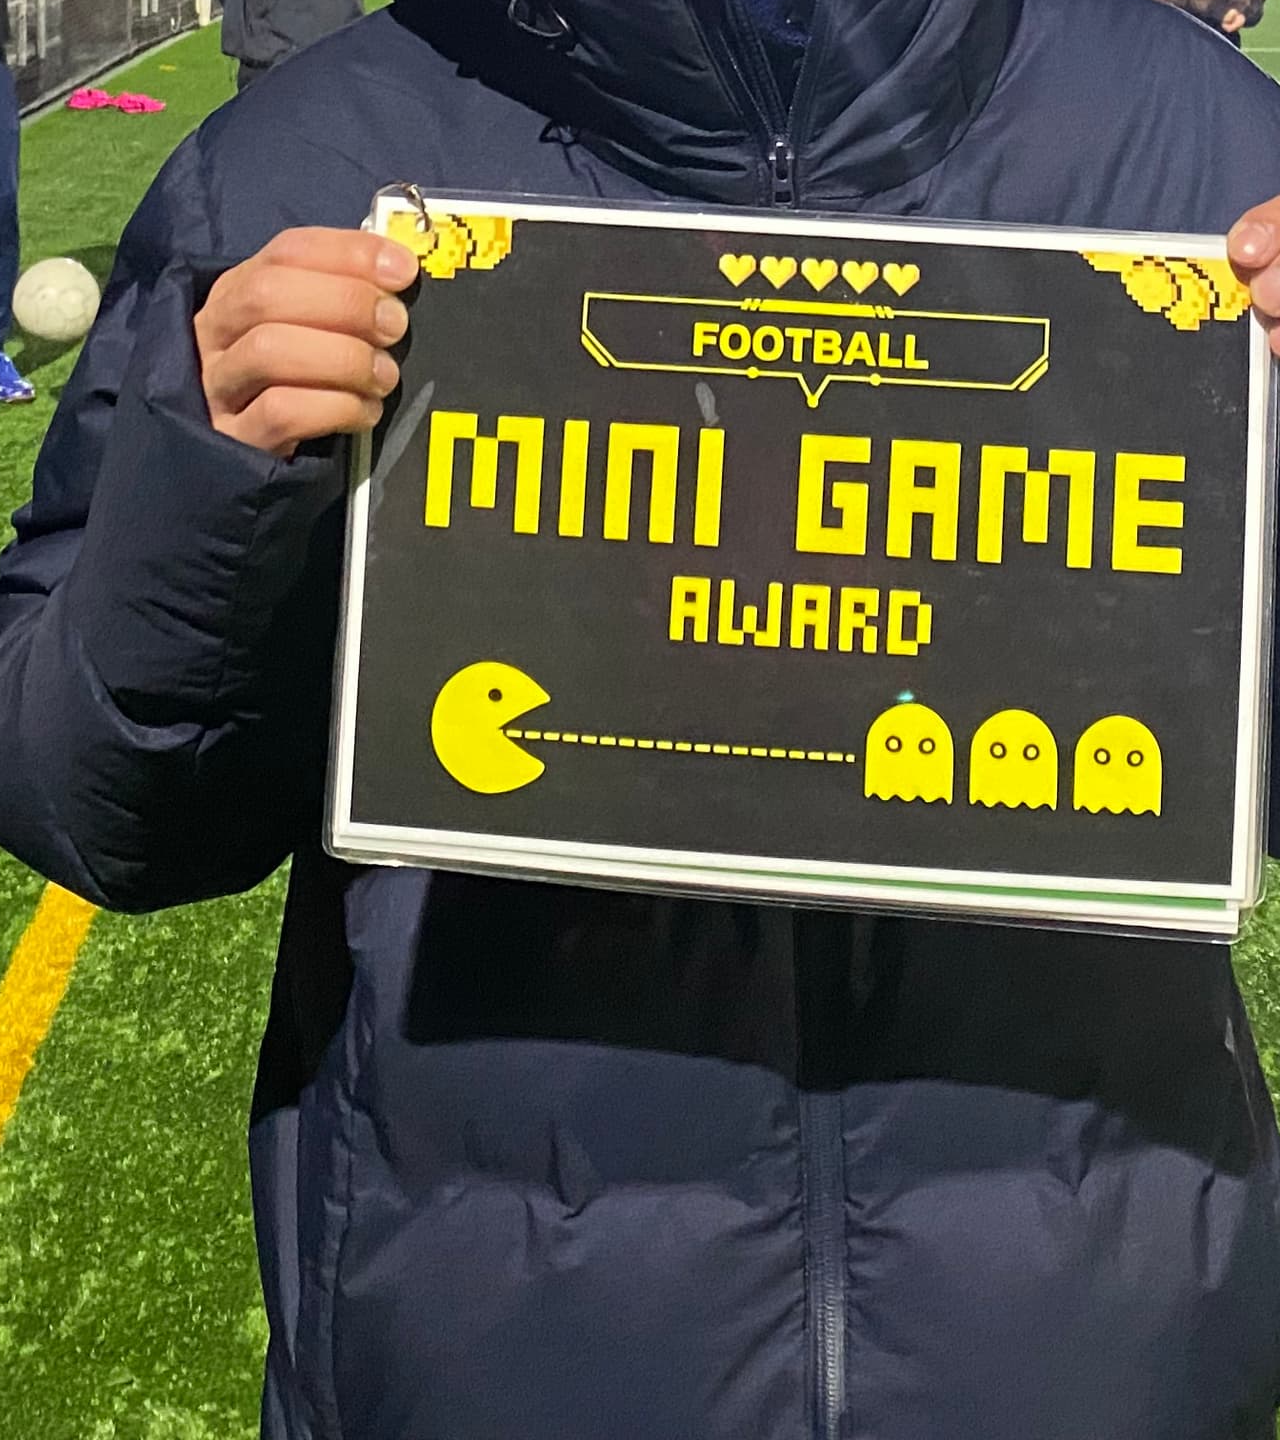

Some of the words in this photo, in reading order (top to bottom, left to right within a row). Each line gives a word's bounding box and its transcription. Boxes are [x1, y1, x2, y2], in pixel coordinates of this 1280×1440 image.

[691, 320, 930, 371] FOOTBALL
[424, 409, 726, 547] MINI
[795, 432, 1186, 574] GAME
[668, 574, 933, 656] AWARD
